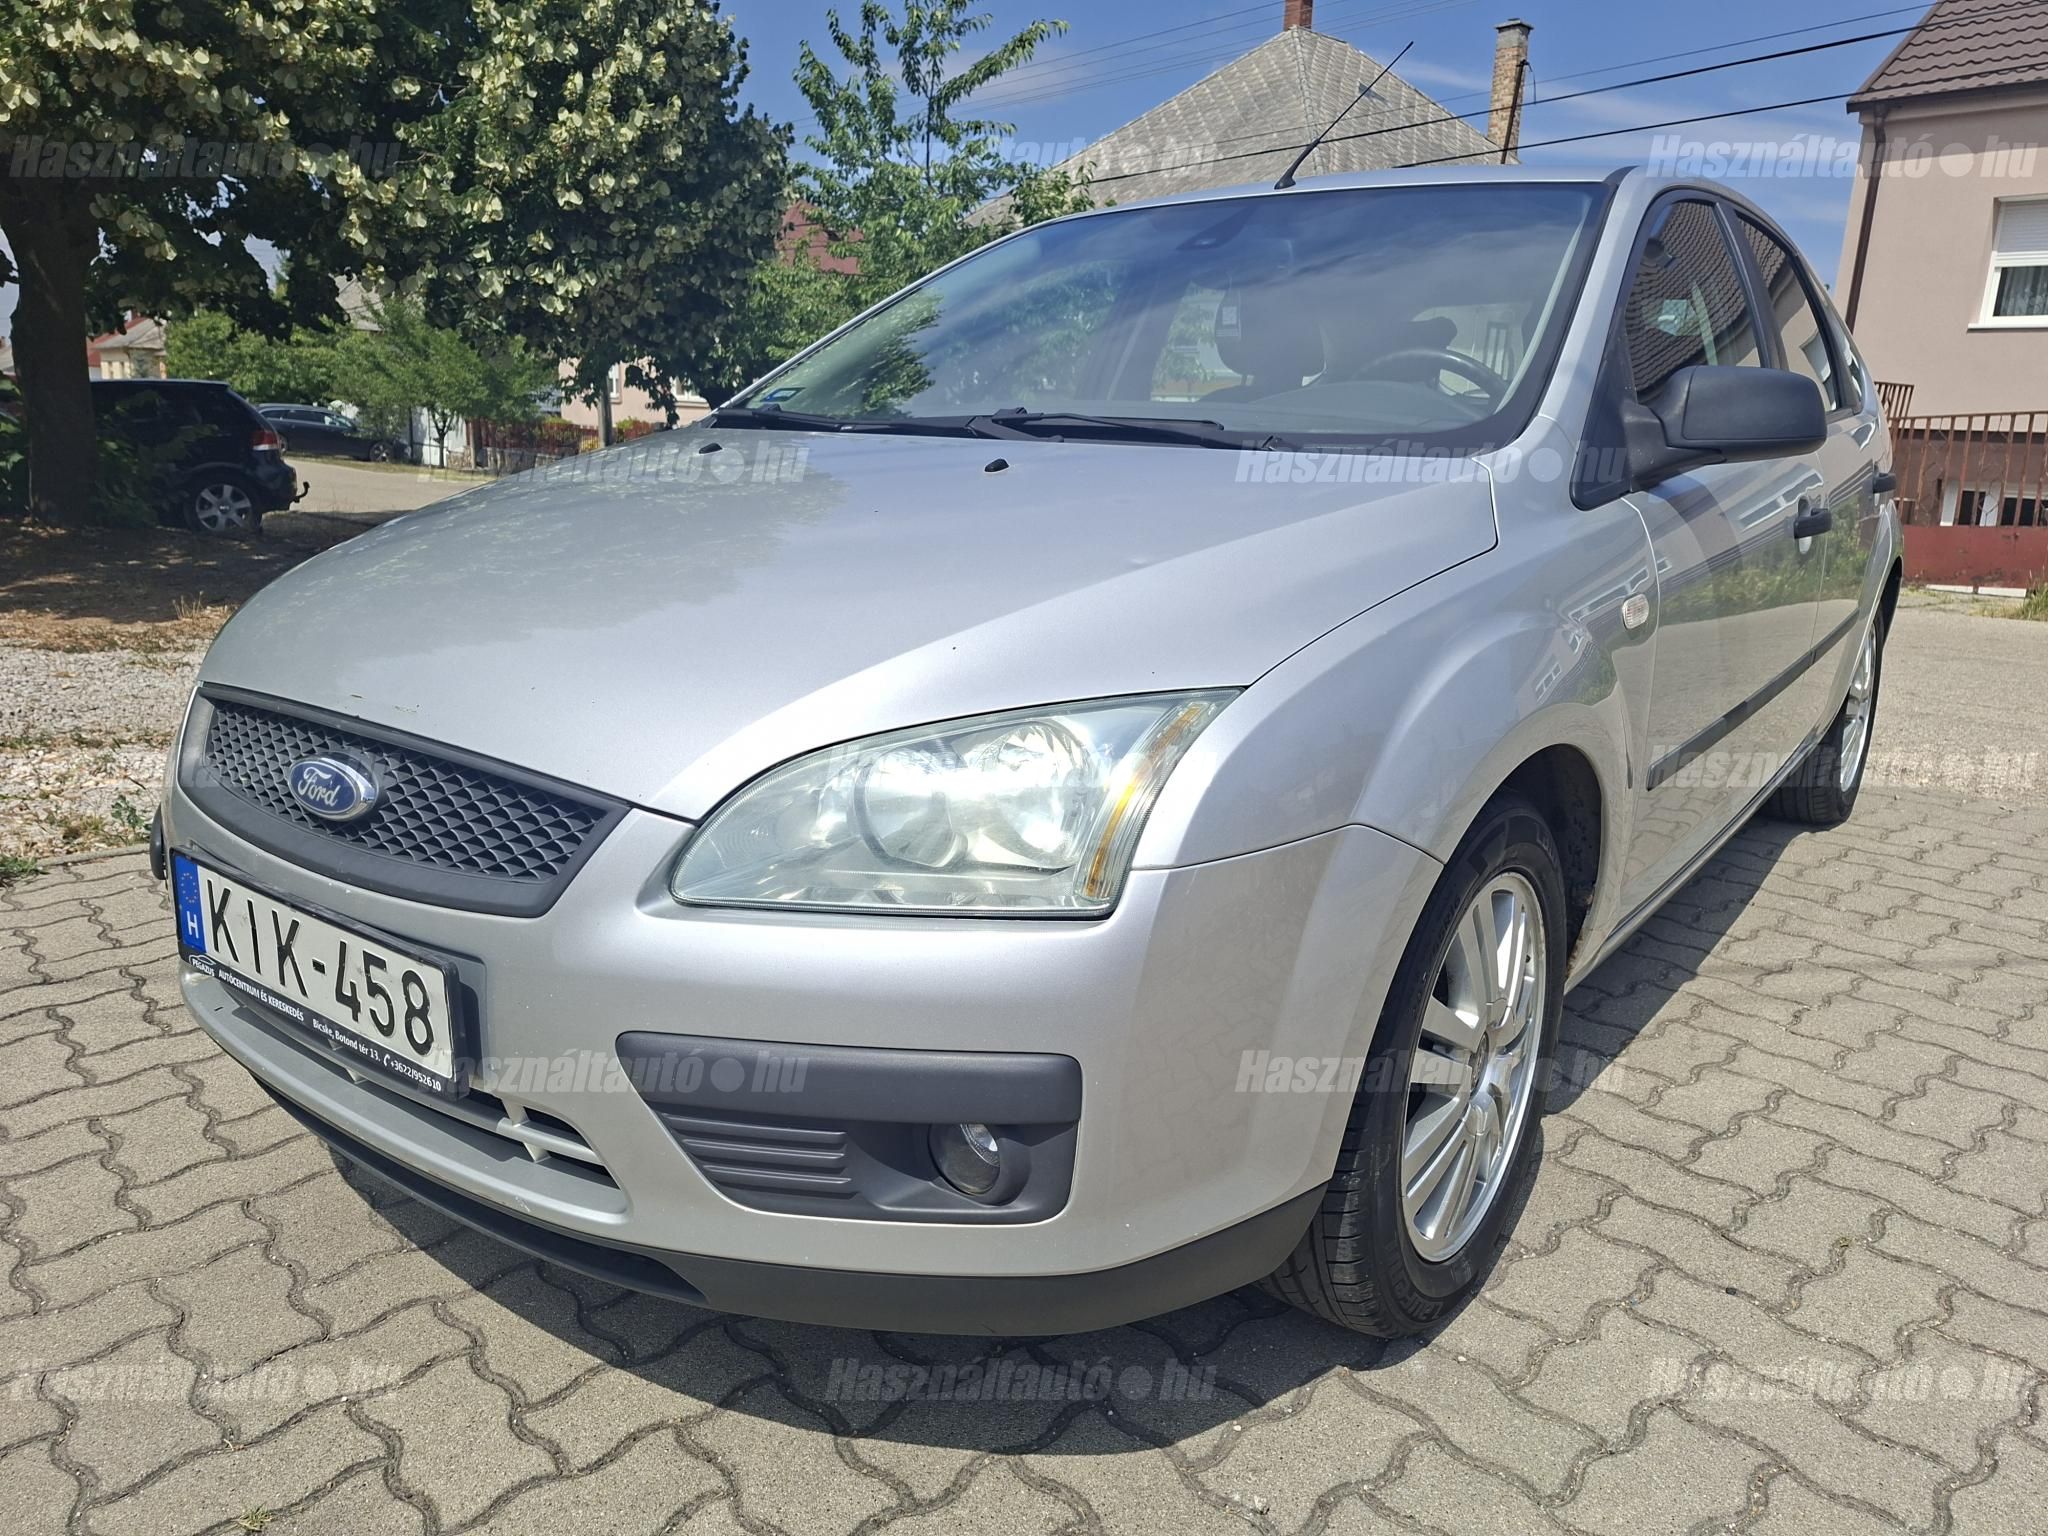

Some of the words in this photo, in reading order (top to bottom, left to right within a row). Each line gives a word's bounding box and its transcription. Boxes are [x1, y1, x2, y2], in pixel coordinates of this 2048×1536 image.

[298, 767, 341, 807] Ford
[186, 910, 199, 939] H
[192, 958, 215, 977] PEGAZUS
[207, 879, 434, 1056] KIK-458
[218, 969, 260, 999] AUTÓCENTRUM
[260, 989, 268, 1002] ÉS
[268, 995, 304, 1021] KERESKEDÉS
[312, 1018, 335, 1039] Bicske,
[335, 1030, 358, 1050] Botond
[359, 1043, 369, 1056] tér
[370, 1048, 381, 1061] 13.
